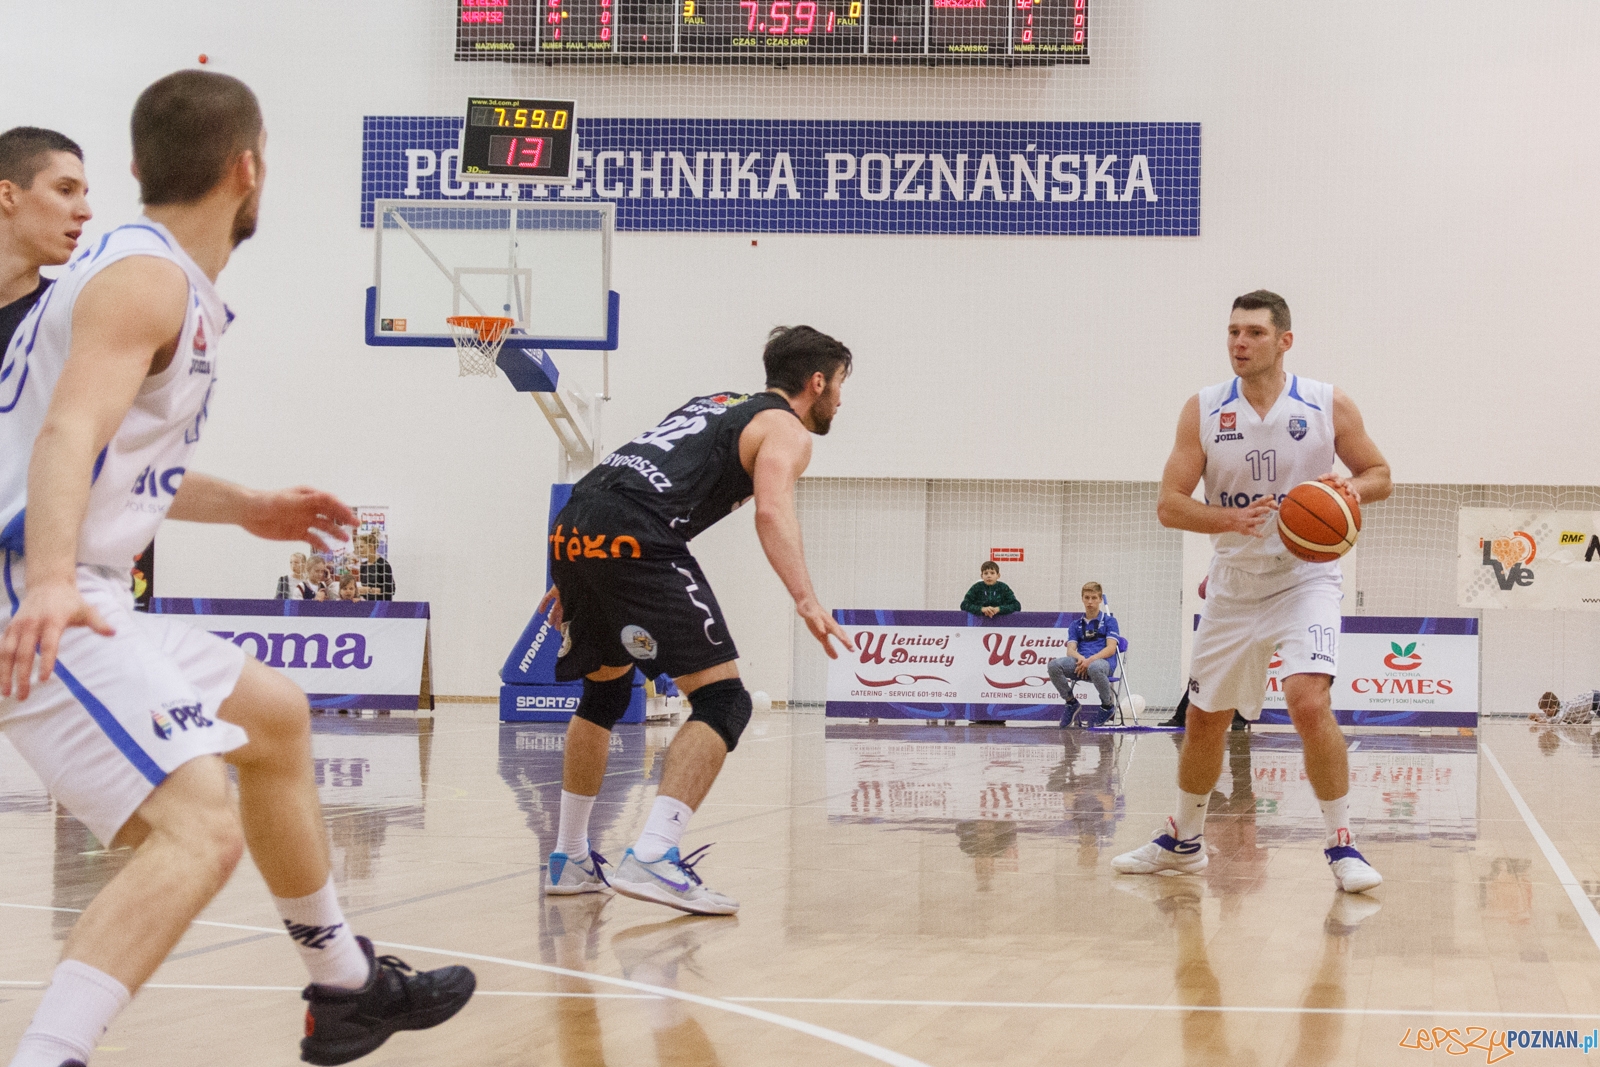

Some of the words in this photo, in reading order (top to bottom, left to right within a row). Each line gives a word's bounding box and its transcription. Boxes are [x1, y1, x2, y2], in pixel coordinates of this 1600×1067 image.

[462, 11, 503, 23] KURPISZ
[548, 11, 560, 24] 14
[601, 11, 610, 24] 0
[850, 1, 862, 17] 0
[1075, 14, 1084, 26] 0
[601, 27, 610, 40] 0
[1022, 30, 1032, 42] 0
[1074, 30, 1084, 42] 0
[506, 138, 544, 168] 13
[824, 144, 1158, 201] POZNAŃSKA
[1246, 449, 1276, 481] 11
[1561, 534, 1584, 543] RMF
[854, 631, 888, 664] U
[891, 633, 950, 650] leniwej
[1309, 624, 1335, 656] 11
[207, 631, 372, 669] oma
[888, 647, 955, 667] Danuty
[983, 633, 1018, 666] U
[888, 690, 916, 698] SERVICE
[1351, 678, 1453, 695] CYMES
